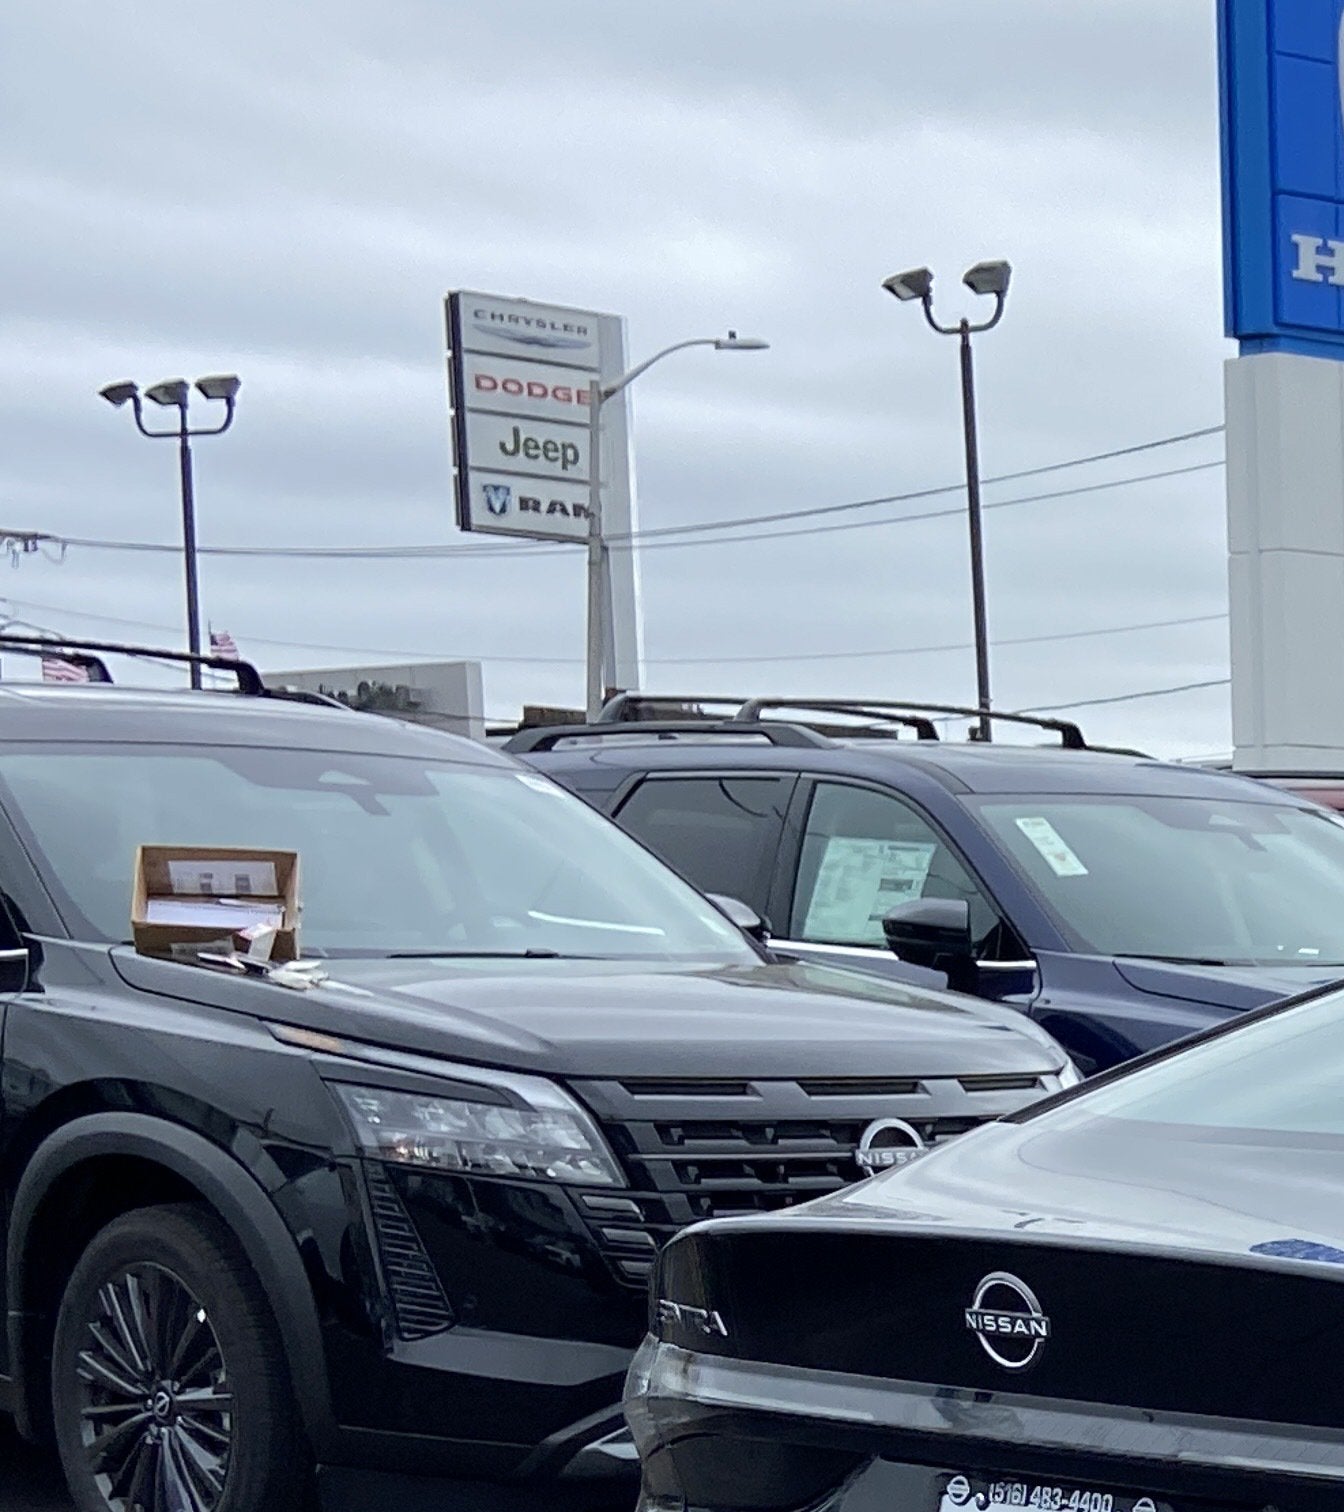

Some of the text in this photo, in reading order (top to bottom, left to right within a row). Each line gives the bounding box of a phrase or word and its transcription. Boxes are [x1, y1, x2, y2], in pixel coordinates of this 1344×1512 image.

[473, 308, 588, 337] CHRYSLER
[474, 373, 591, 405] DODGE
[499, 425, 581, 470] Jeep
[859, 1151, 920, 1165] NISSA
[966, 1310, 1048, 1338] NISSAN
